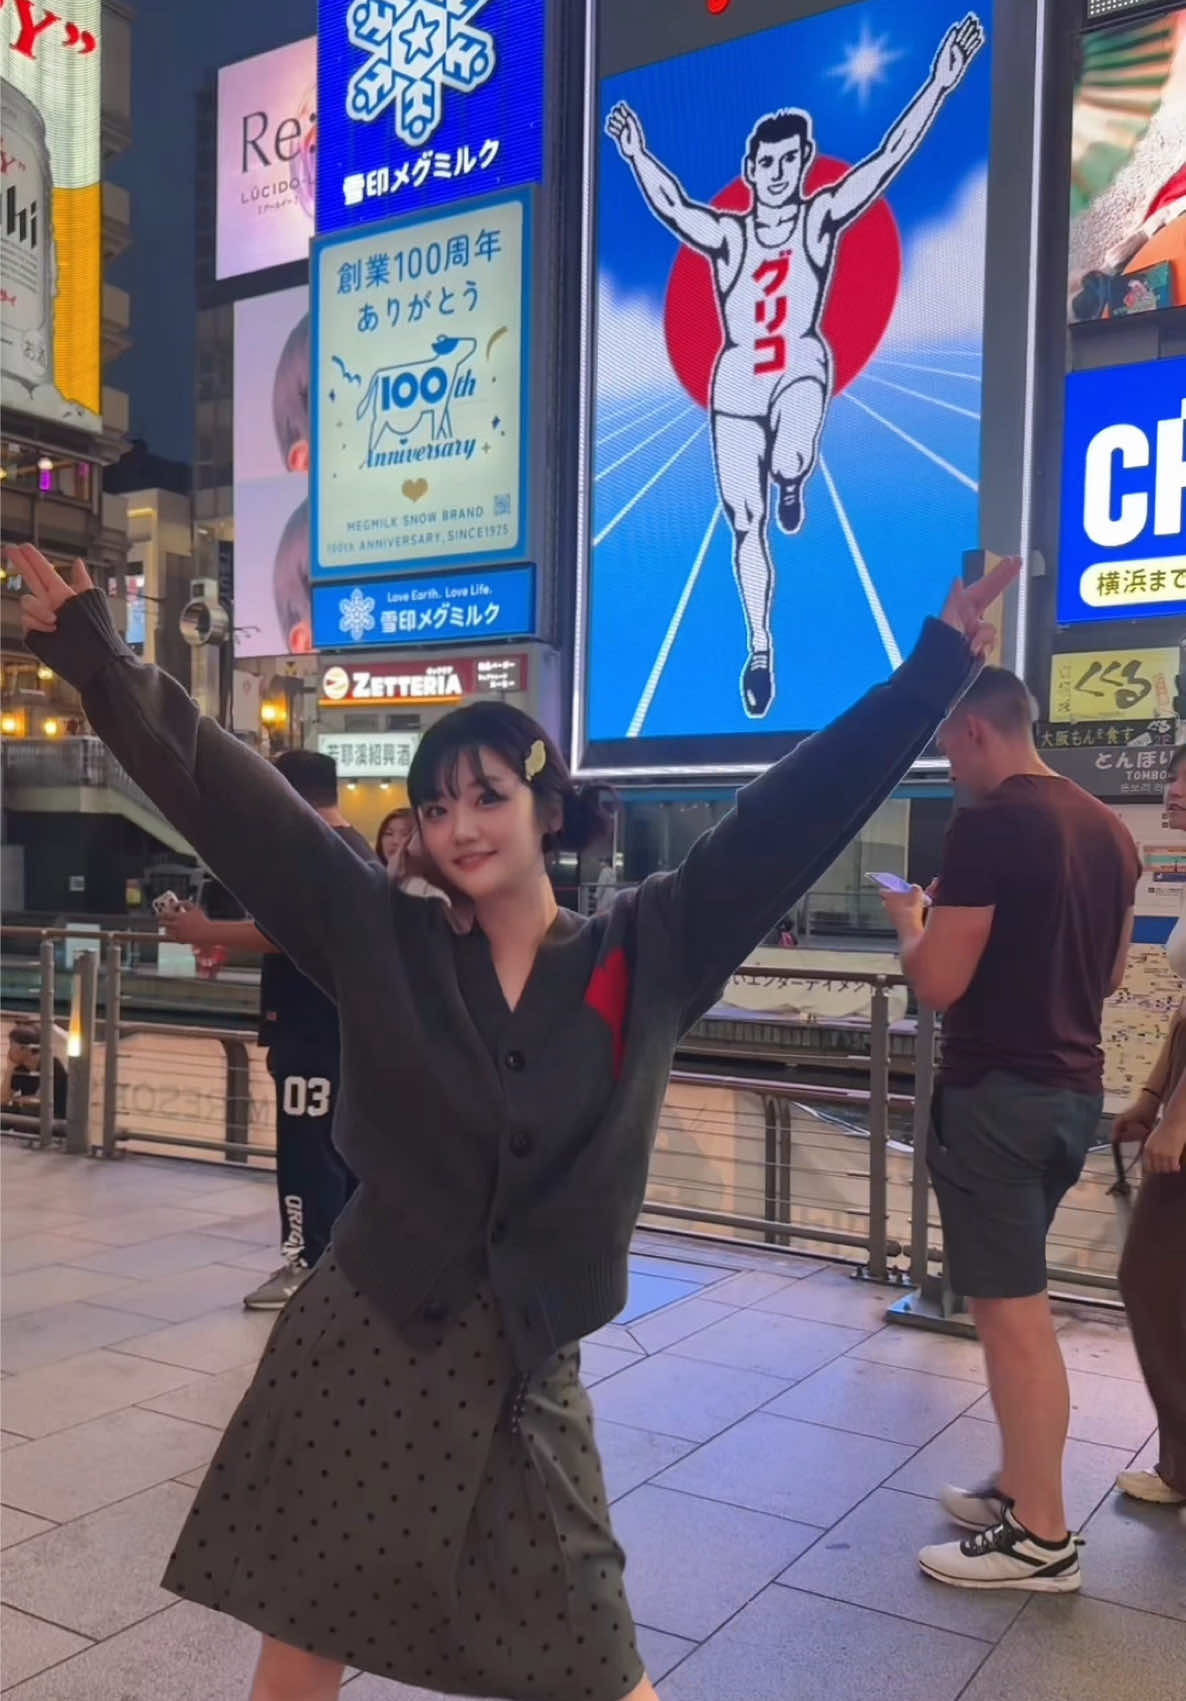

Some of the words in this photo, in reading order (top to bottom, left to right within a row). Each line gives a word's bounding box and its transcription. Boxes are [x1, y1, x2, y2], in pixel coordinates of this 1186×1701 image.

[343, 139, 499, 206] 雪印メグミルク
[337, 228, 502, 294] 創業100周年
[357, 280, 478, 332] ありがとう
[752, 249, 792, 375] グリコ
[347, 517, 398, 533] MEGMILK
[403, 511, 437, 527] SNOW
[442, 506, 484, 521] BRAND
[387, 592, 410, 603] Love
[445, 586, 468, 598] Love
[470, 584, 492, 596] Life.
[380, 601, 500, 633] 雪印メグミルク
[352, 672, 463, 698] ZETTERIA
[1075, 659, 1152, 709] くくる
[284, 1076, 331, 1116] 03
